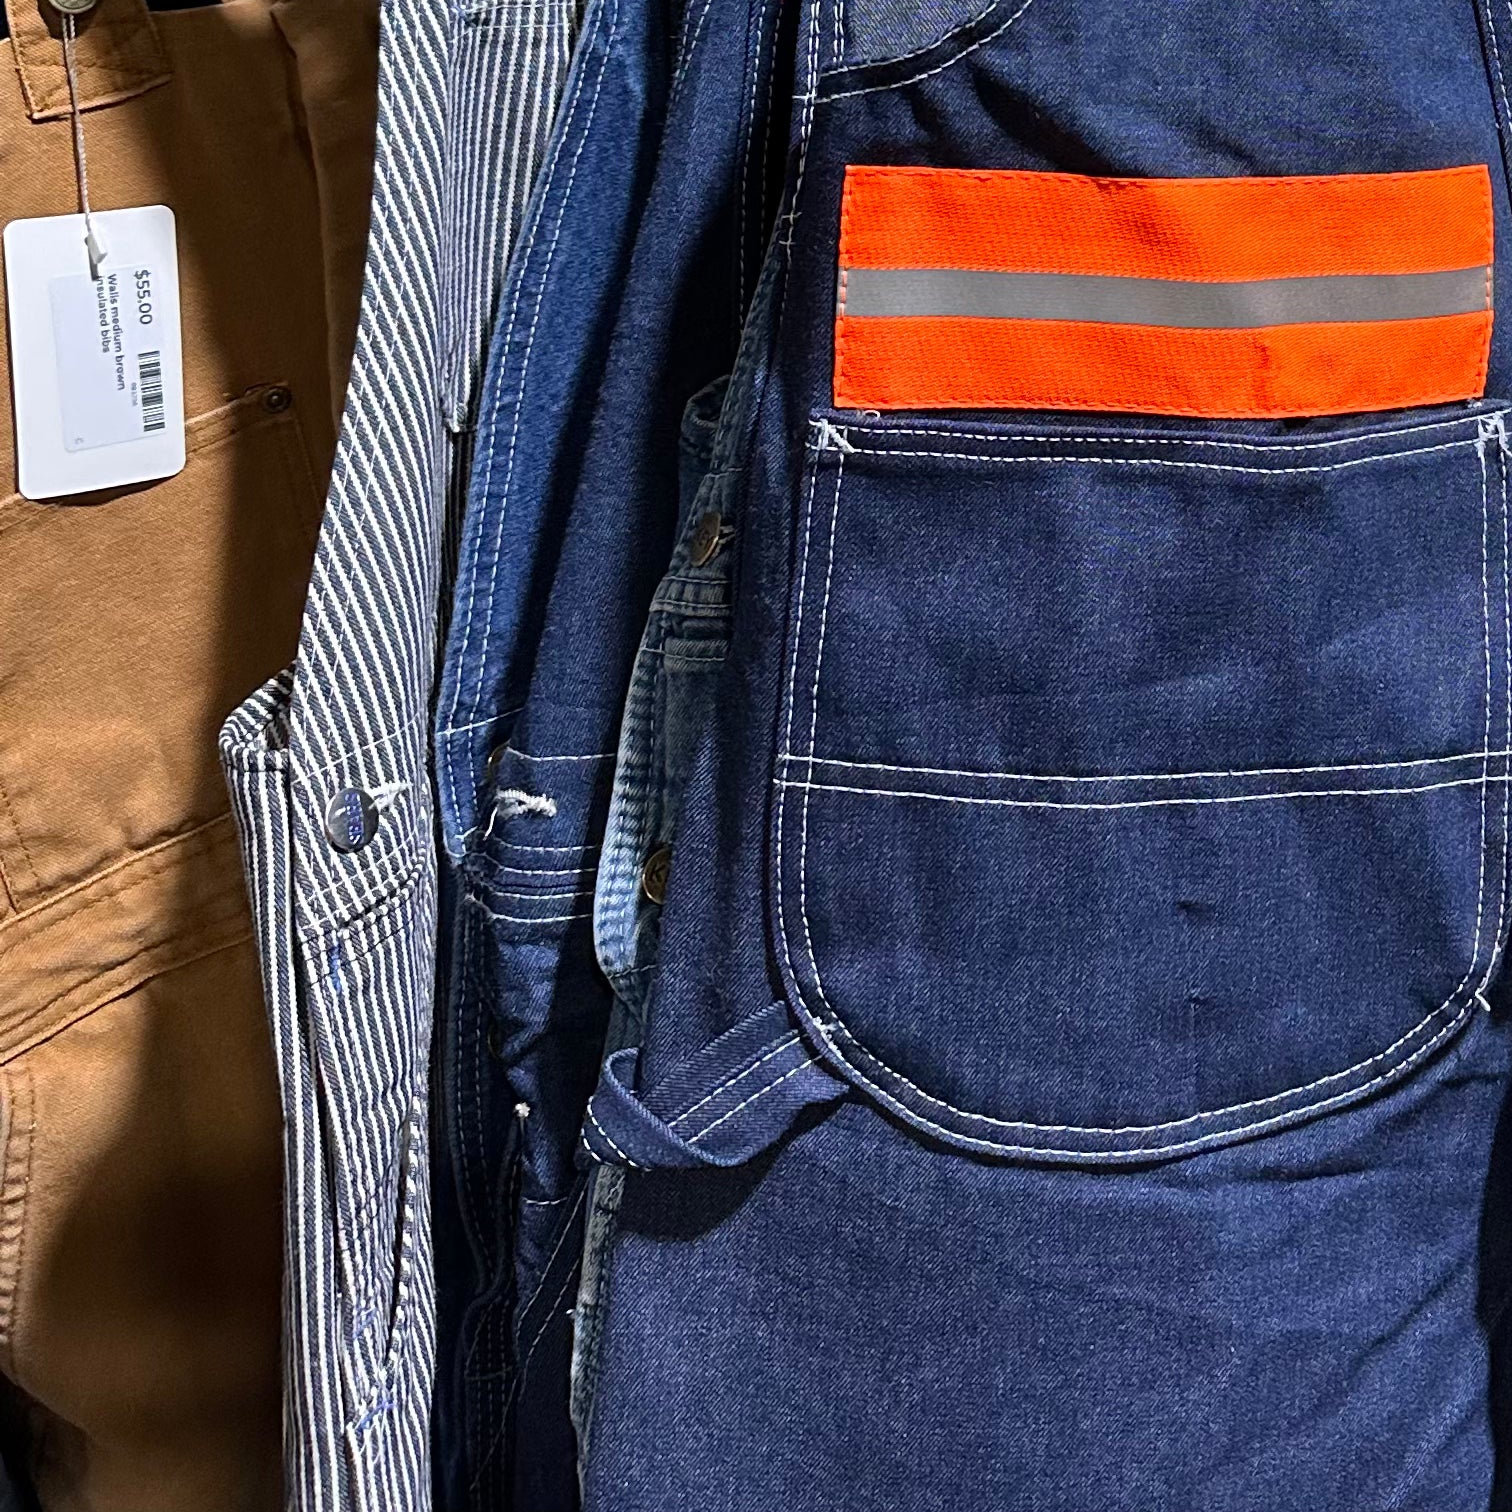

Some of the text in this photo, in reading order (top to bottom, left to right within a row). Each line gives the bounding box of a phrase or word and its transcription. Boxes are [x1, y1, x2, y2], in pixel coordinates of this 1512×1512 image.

[133, 269, 153, 325] $55.00
[101, 329, 112, 354] bibs
[111, 306, 124, 353] medium
[115, 354, 126, 391] brown
